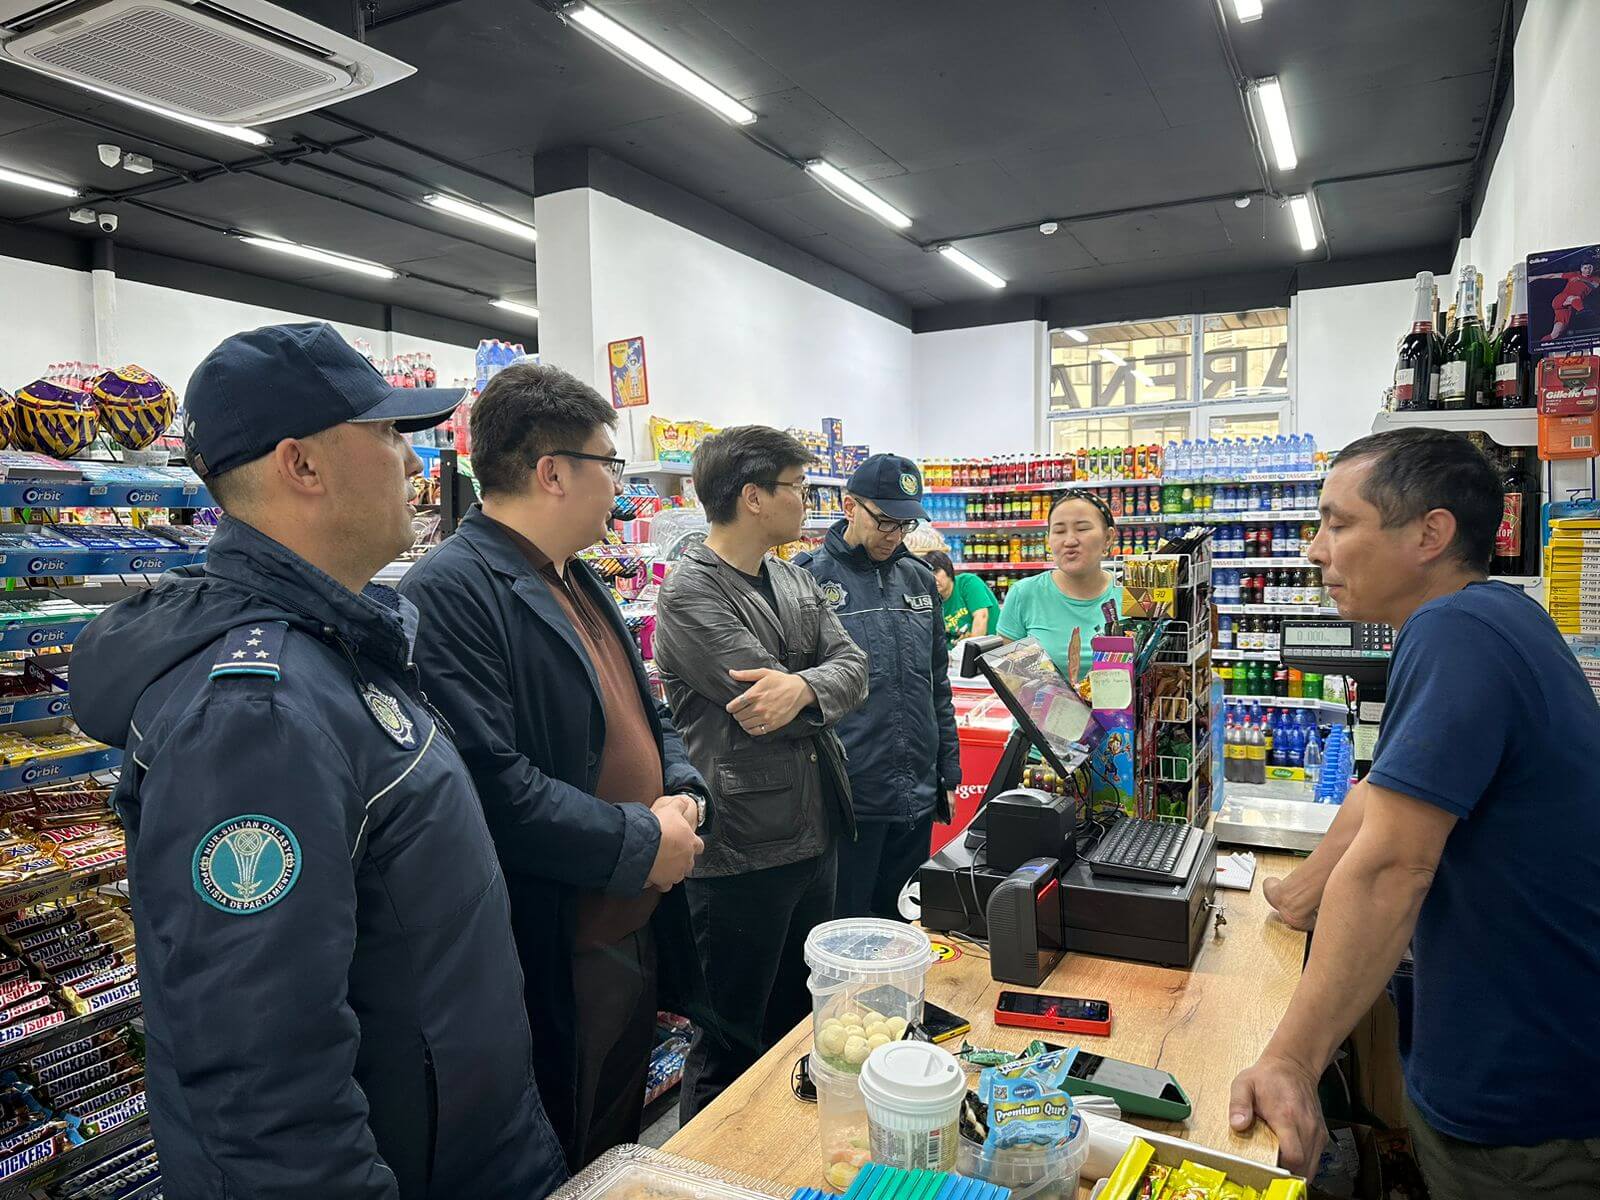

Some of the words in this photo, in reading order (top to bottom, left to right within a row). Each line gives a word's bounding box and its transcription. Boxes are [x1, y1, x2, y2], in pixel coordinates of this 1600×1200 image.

[1546, 390, 1580, 399] Gillette
[25, 488, 62, 501] Orbit
[129, 489, 159, 501] Orbit
[31, 557, 65, 571] Orbit
[132, 557, 162, 569] Orbit
[31, 630, 65, 642] Orbit
[29, 664, 46, 682] Orbit
[25, 766, 60, 780] Orbit
[203, 820, 260, 855] NUR-SULTAN
[201, 872, 227, 905] POLISIA
[229, 869, 294, 910] DEPARTAMENTI
[6, 908, 67, 933] SNICKERS
[23, 922, 81, 948] SNICKERS
[31, 932, 90, 962] SNICKERS
[55, 955, 114, 984] SNICKERS
[5, 983, 41, 1002] SUPER
[29, 1012, 64, 1032] SUPER
[32, 1038, 92, 1070] SNICKERS
[41, 1049, 101, 1080] SNICKERS
[49, 1062, 109, 1095] SNICKERS
[71, 1085, 130, 1116] SNICKERS
[996, 1104, 1040, 1122] Premium
[1044, 1102, 1067, 1116] Qurt
[29, 1155, 48, 1169] CRISP
